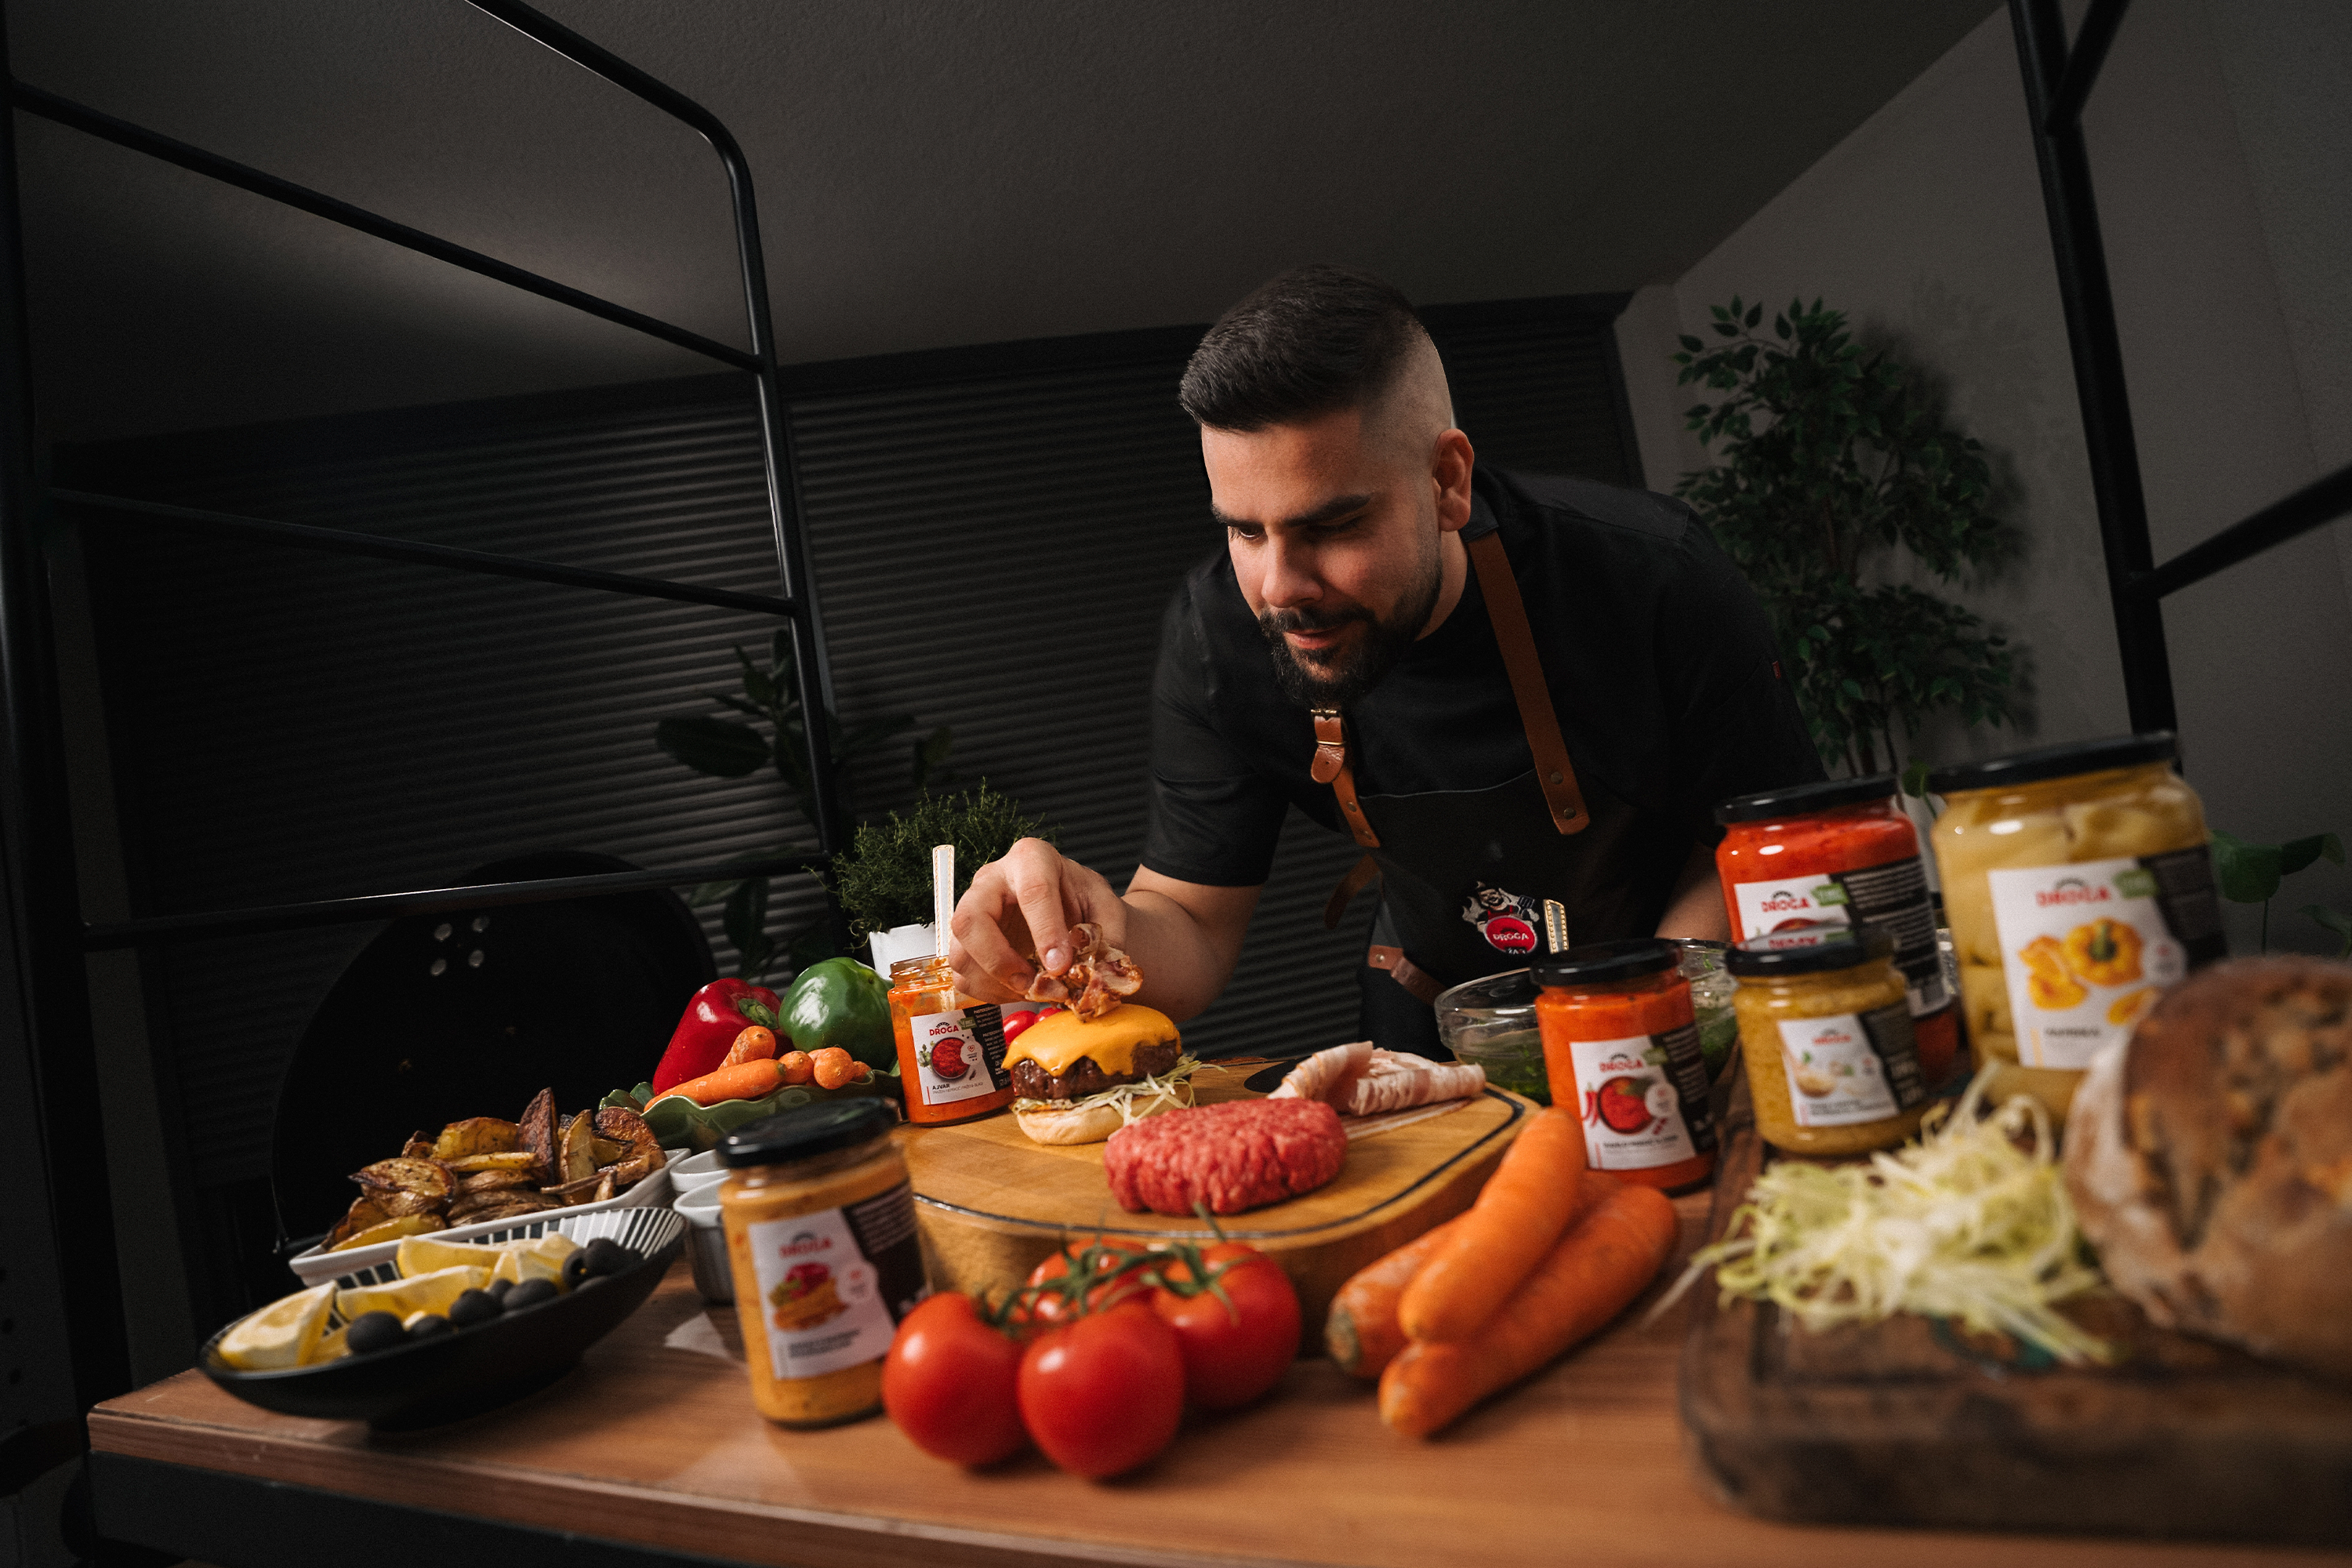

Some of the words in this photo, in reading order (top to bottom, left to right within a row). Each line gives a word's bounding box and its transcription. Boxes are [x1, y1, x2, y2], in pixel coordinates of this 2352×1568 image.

[1762, 897, 1810, 912] DROGA
[1493, 932, 1529, 941] DROGA
[929, 1025, 959, 1036] DROGA
